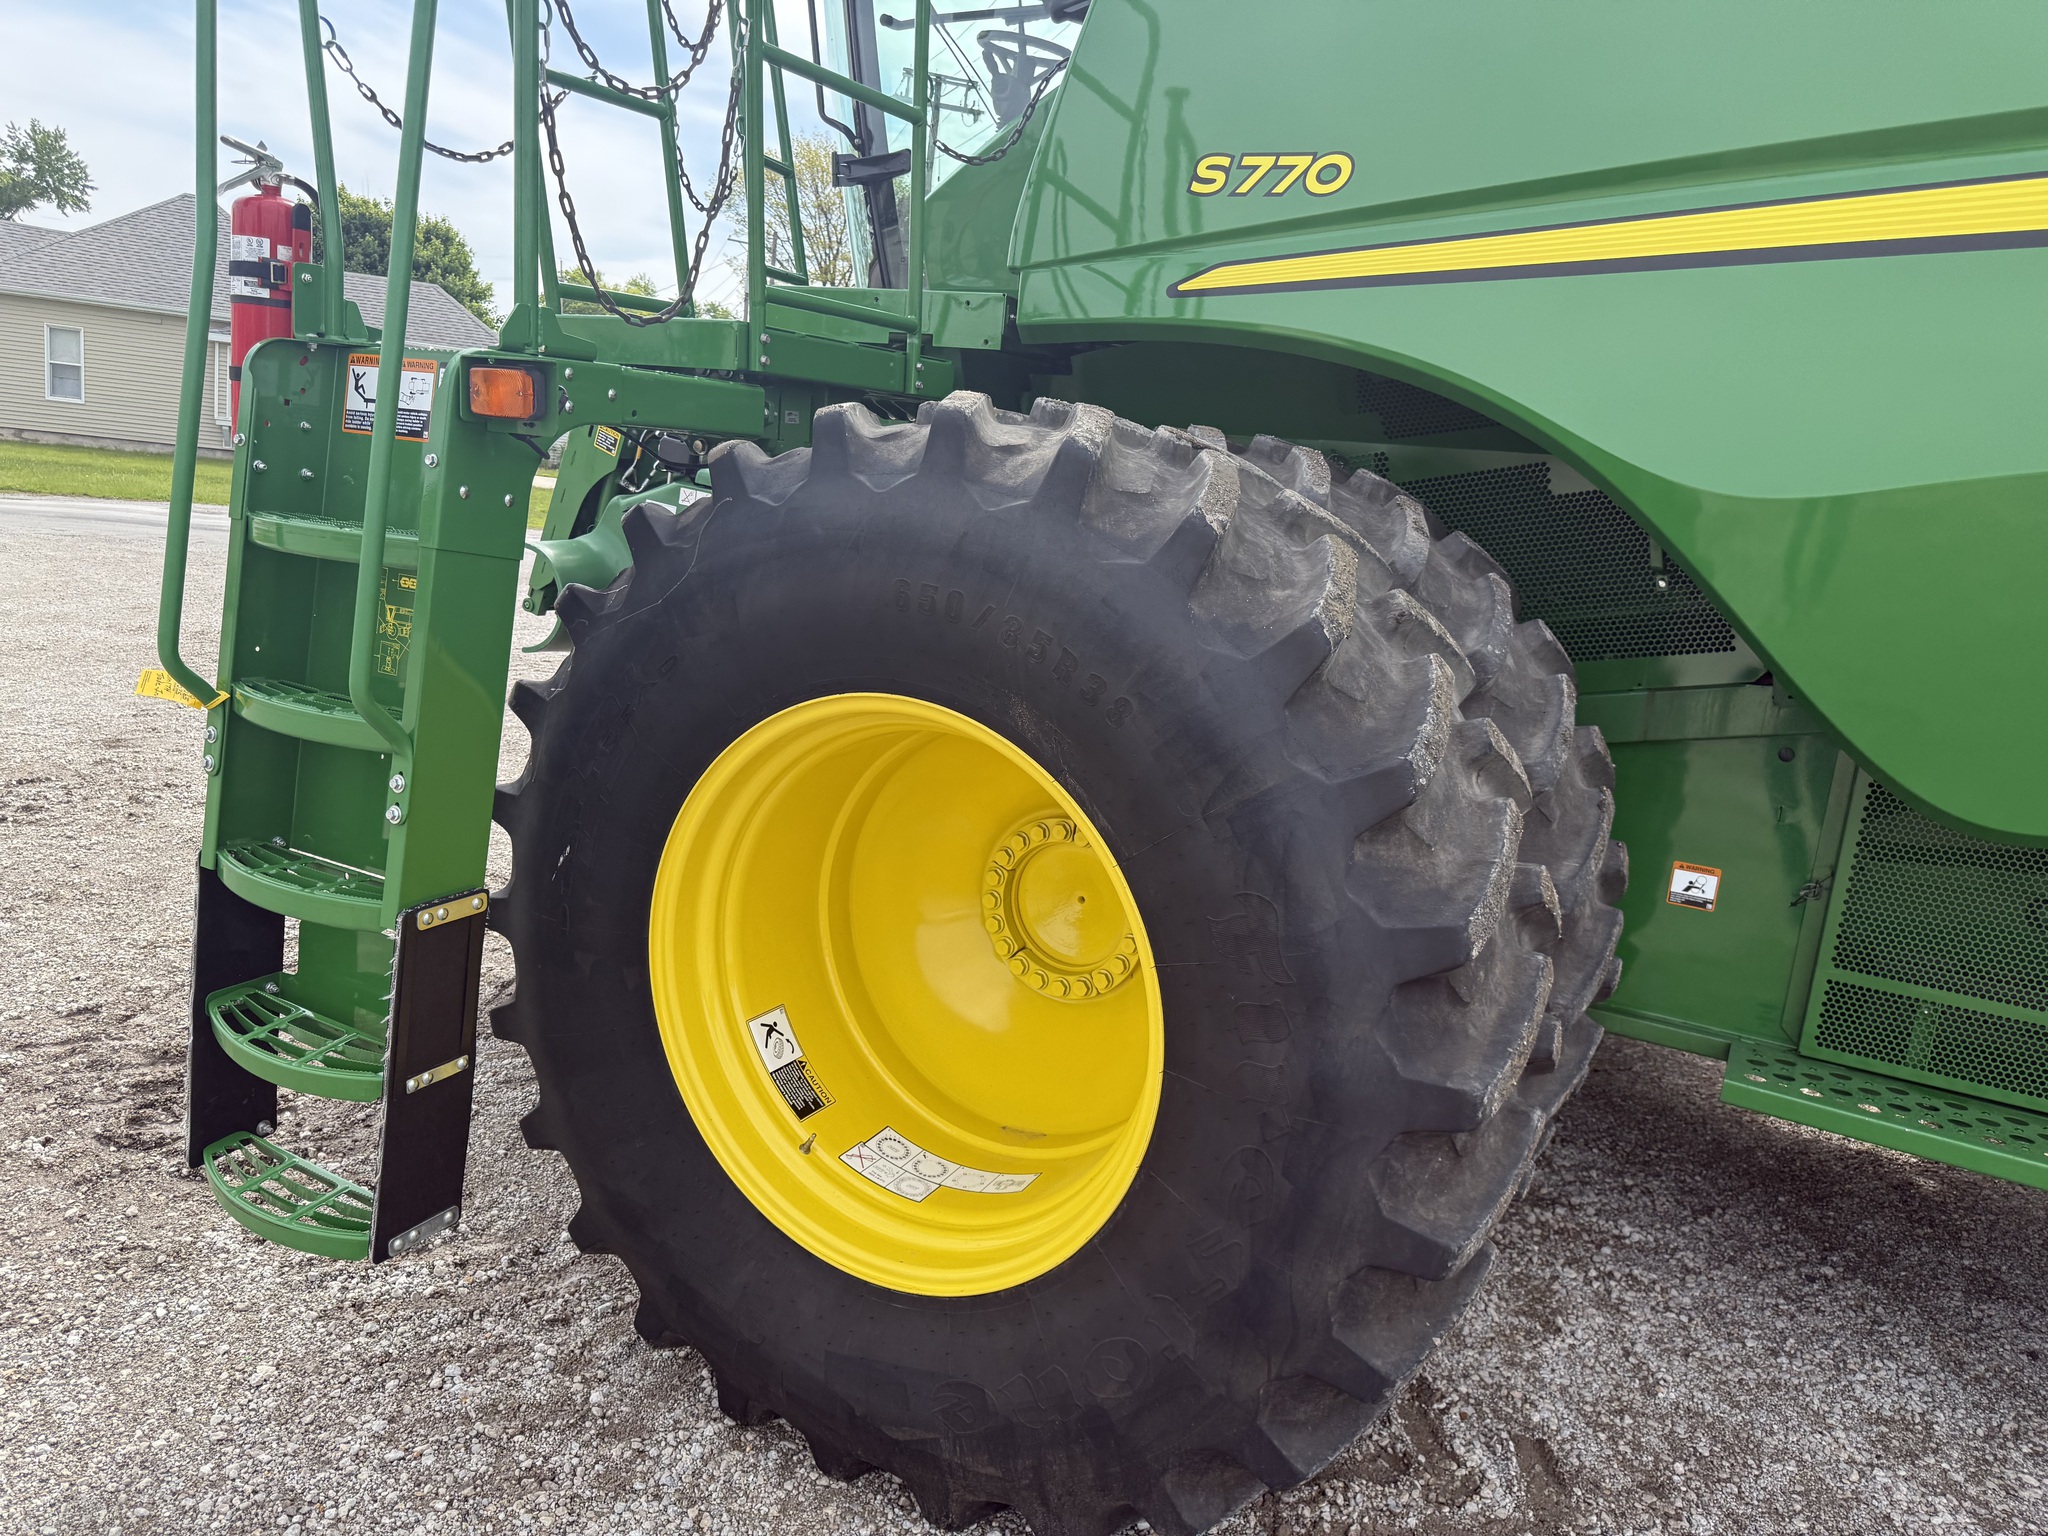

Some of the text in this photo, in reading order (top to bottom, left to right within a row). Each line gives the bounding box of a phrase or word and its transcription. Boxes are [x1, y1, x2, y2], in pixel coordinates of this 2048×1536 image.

[1187, 151, 1355, 197] S770
[356, 356, 380, 365] WARNIN
[406, 361, 434, 370] WARNING
[1686, 865, 1715, 875] WARNING
[805, 1069, 832, 1104] CAUTION
